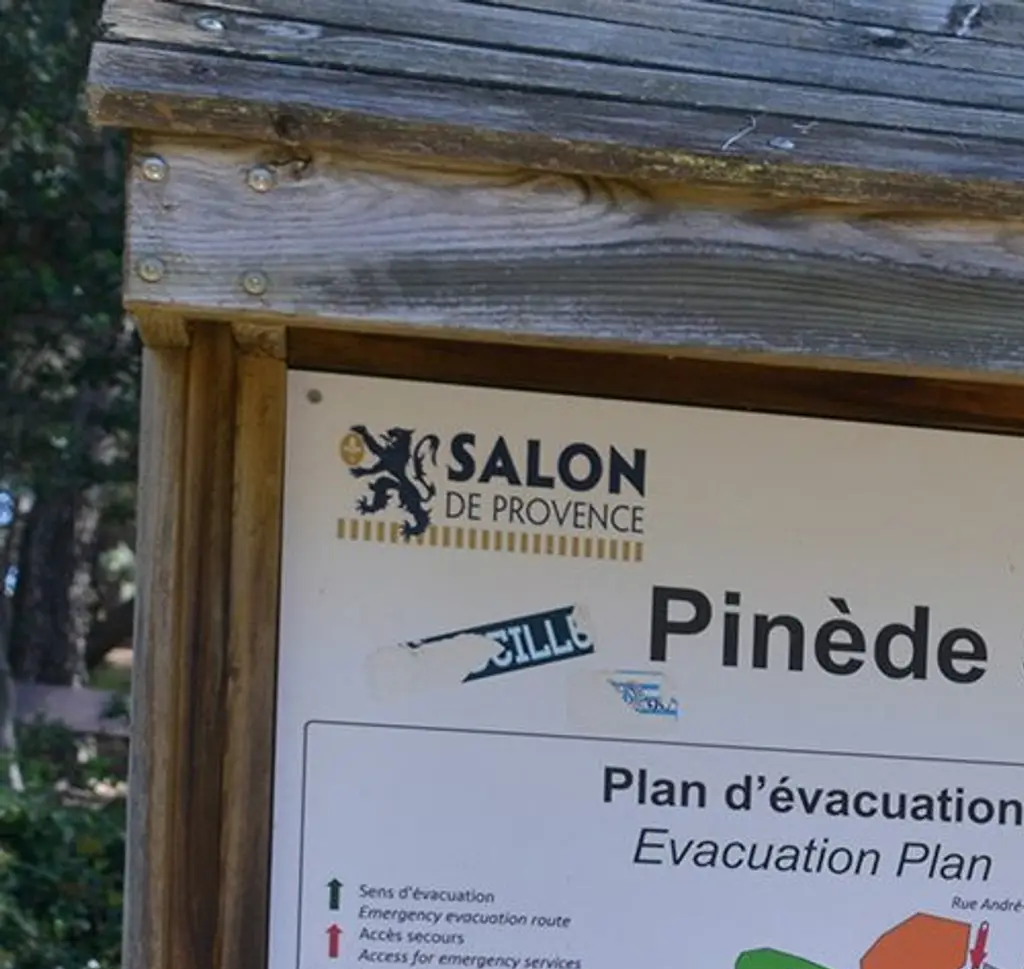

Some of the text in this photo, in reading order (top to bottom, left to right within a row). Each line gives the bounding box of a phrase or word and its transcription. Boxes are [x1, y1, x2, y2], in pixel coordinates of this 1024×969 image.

[447, 432, 646, 497] SALON
[445, 490, 644, 534] DE PROVENCE
[649, 585, 988, 684] Pinède
[603, 766, 1022, 826] Plan d'évacuation
[633, 827, 992, 881] Evacuation Plan
[359, 883, 495, 903] Sens d'évacuation
[951, 896, 978, 910] Rue
[358, 904, 571, 928] Emergency evacuation route
[358, 927, 464, 945] Accès secours
[357, 948, 581, 969] Access for emergency services
